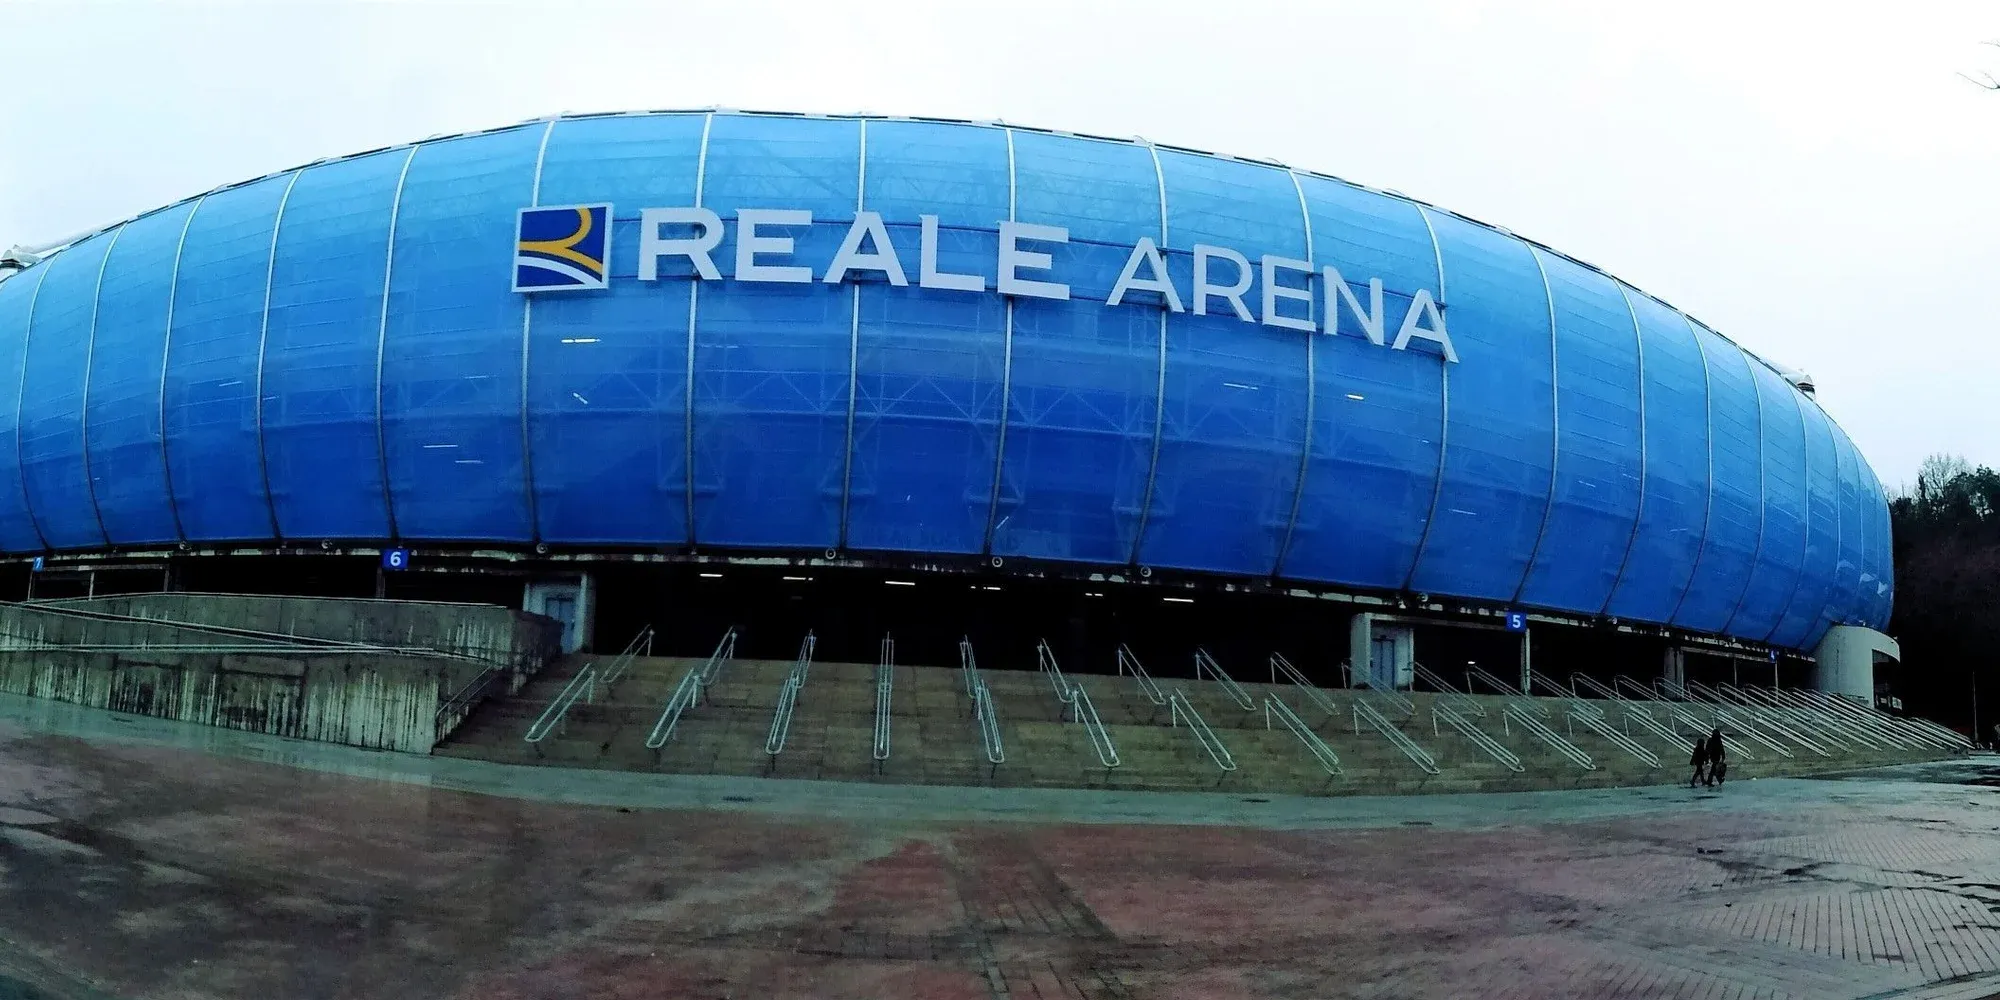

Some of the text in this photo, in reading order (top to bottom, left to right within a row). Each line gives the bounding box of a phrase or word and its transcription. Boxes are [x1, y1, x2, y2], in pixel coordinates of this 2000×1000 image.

[638, 207, 1459, 363] REALE ARENA
[390, 551, 401, 567] 6
[1512, 614, 1521, 629] 5
